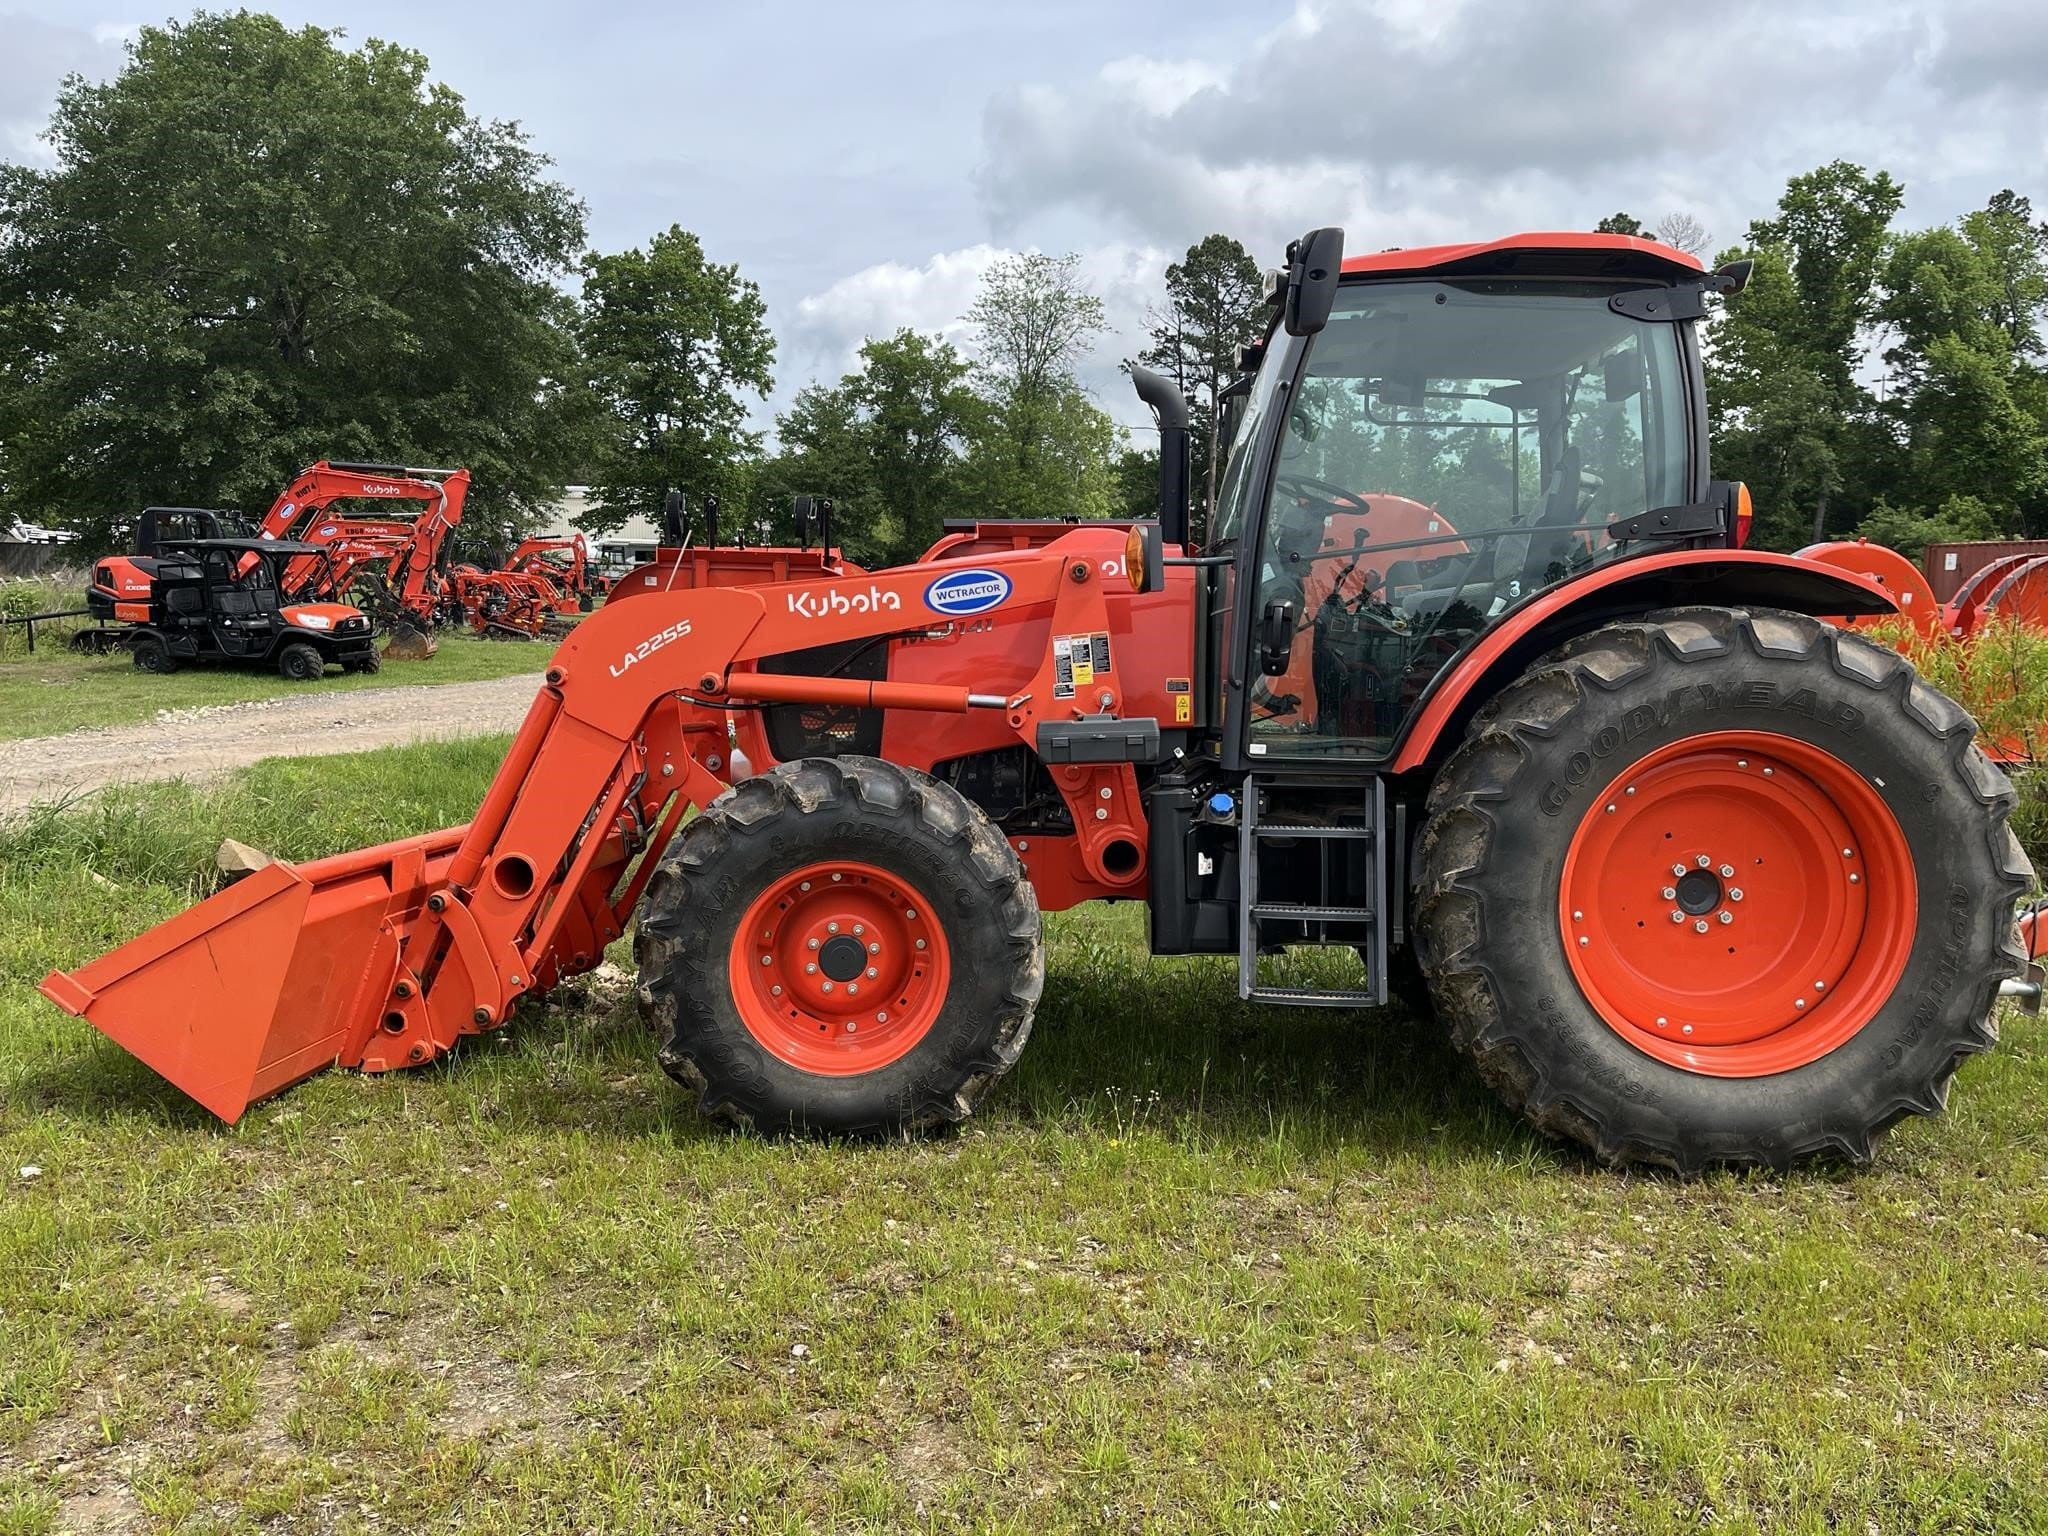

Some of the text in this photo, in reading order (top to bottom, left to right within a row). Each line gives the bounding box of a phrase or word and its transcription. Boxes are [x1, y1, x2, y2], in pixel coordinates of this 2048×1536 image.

[363, 484, 400, 494] Kubota
[787, 585, 901, 618] Kubota
[936, 584, 1001, 601] WCTRACTOR
[609, 619, 692, 677] LA2255
[1539, 680, 1866, 817] GOODYEAR
[832, 821, 975, 906] OPTITRAC
[1879, 883, 1969, 1070] OPTITRAC
